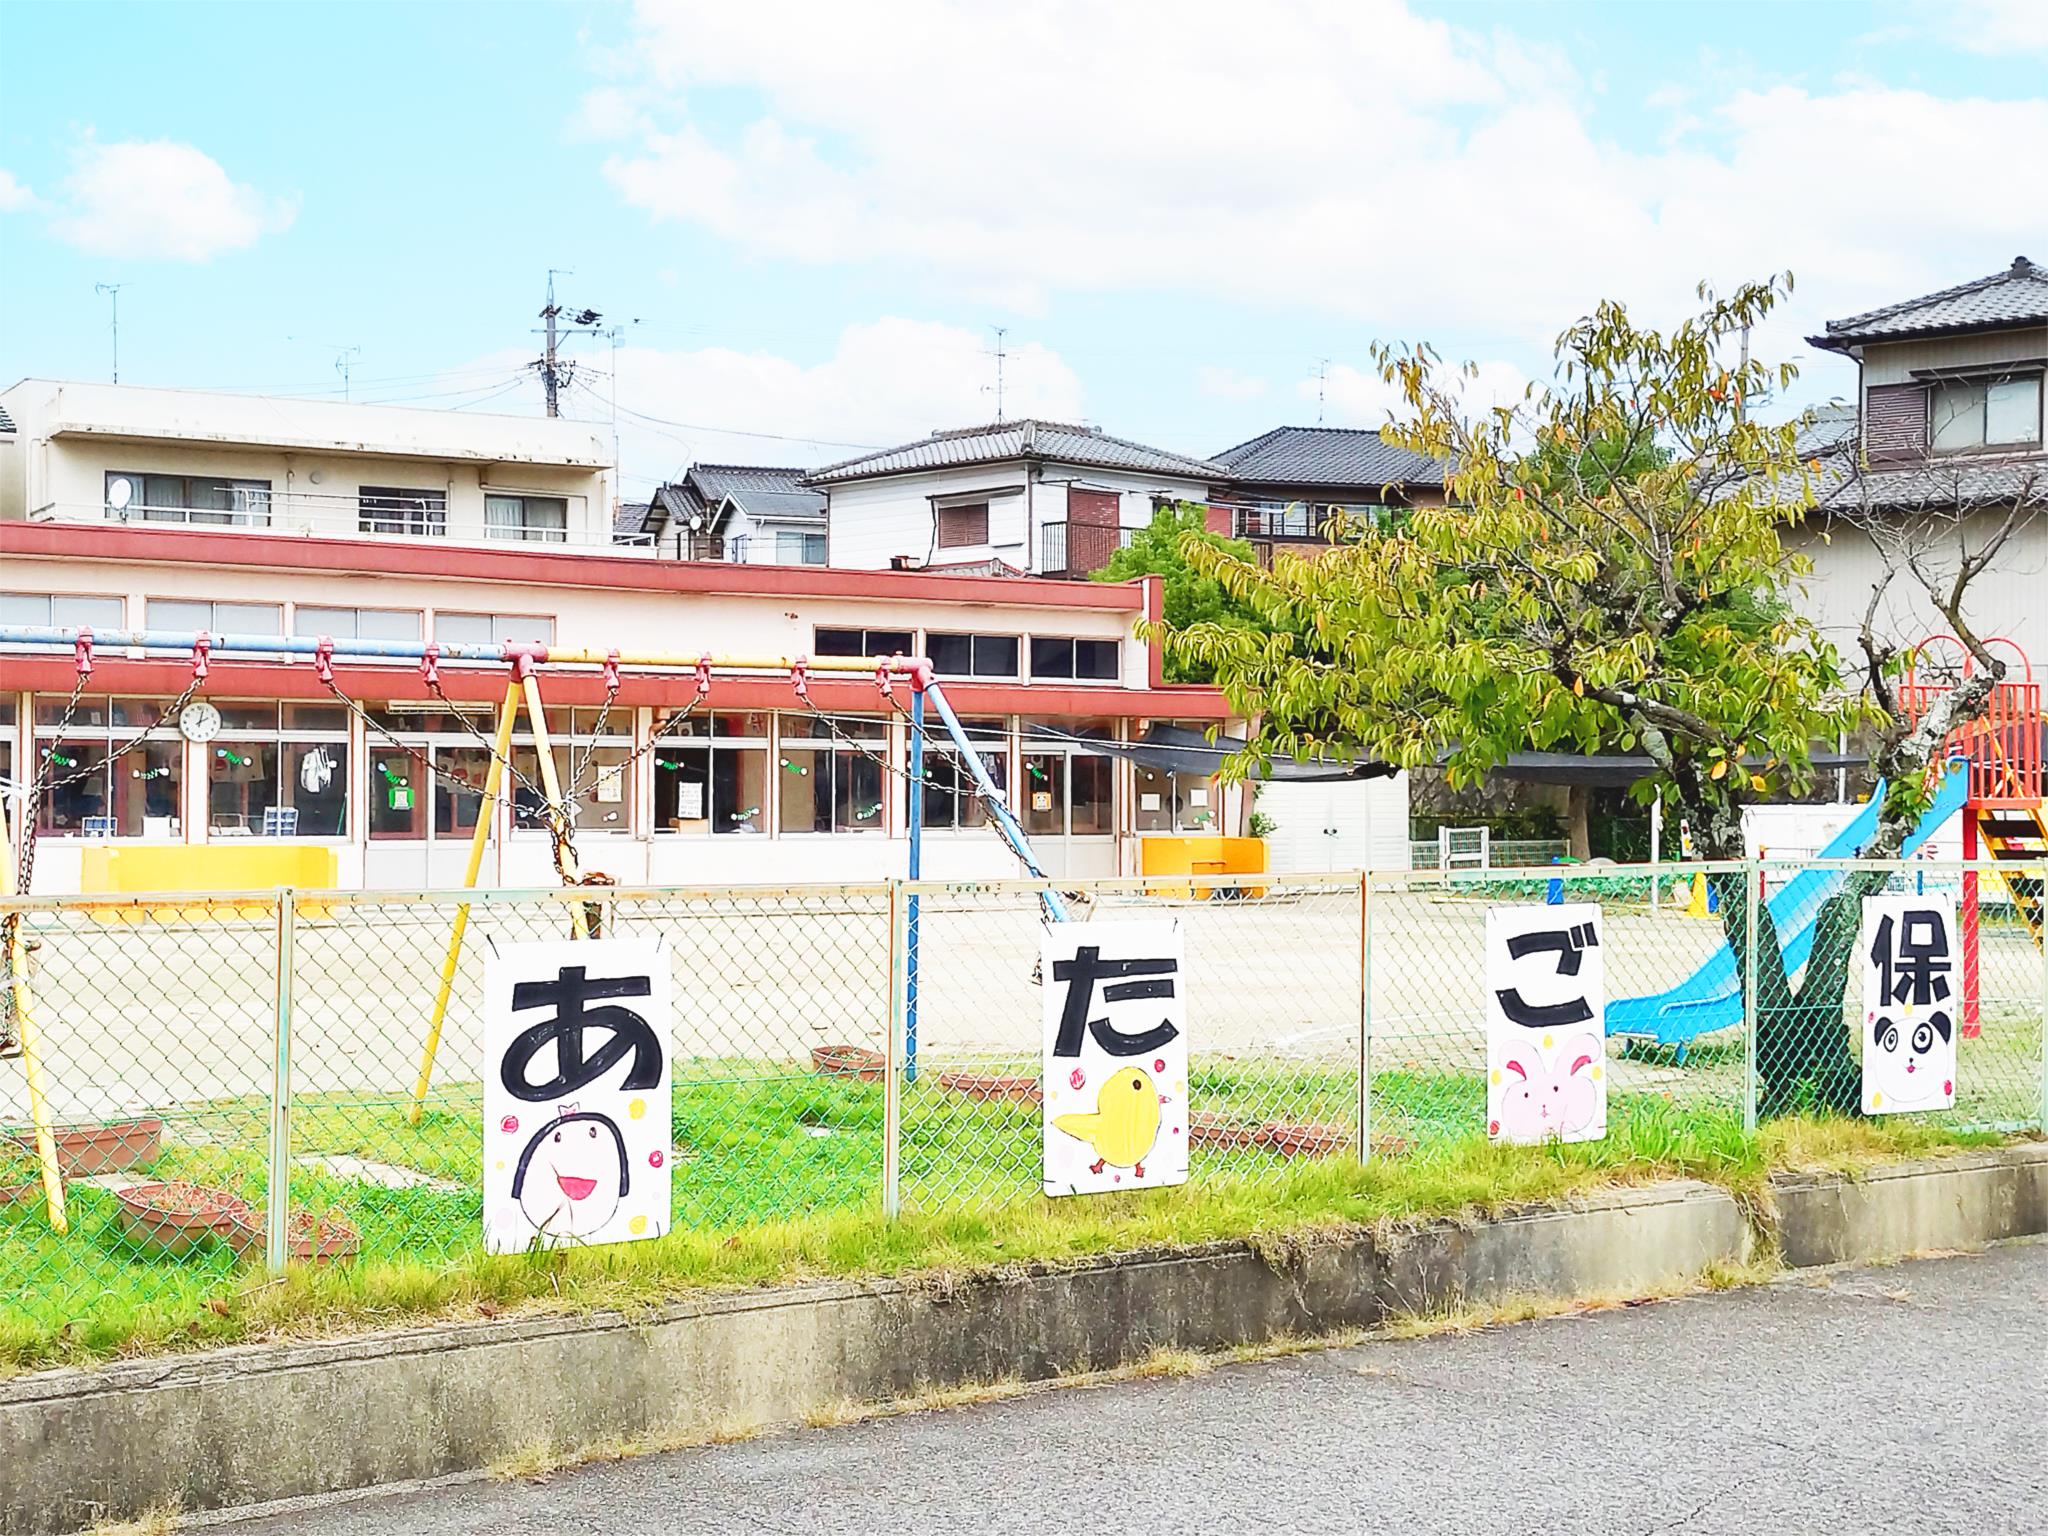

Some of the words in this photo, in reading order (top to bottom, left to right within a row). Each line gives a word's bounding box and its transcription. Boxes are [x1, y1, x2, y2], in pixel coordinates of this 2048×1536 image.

[1052, 945, 1180, 1058] た
[1495, 921, 1599, 1029] ご
[1870, 909, 1952, 1007] 保
[500, 965, 663, 1103] あ
